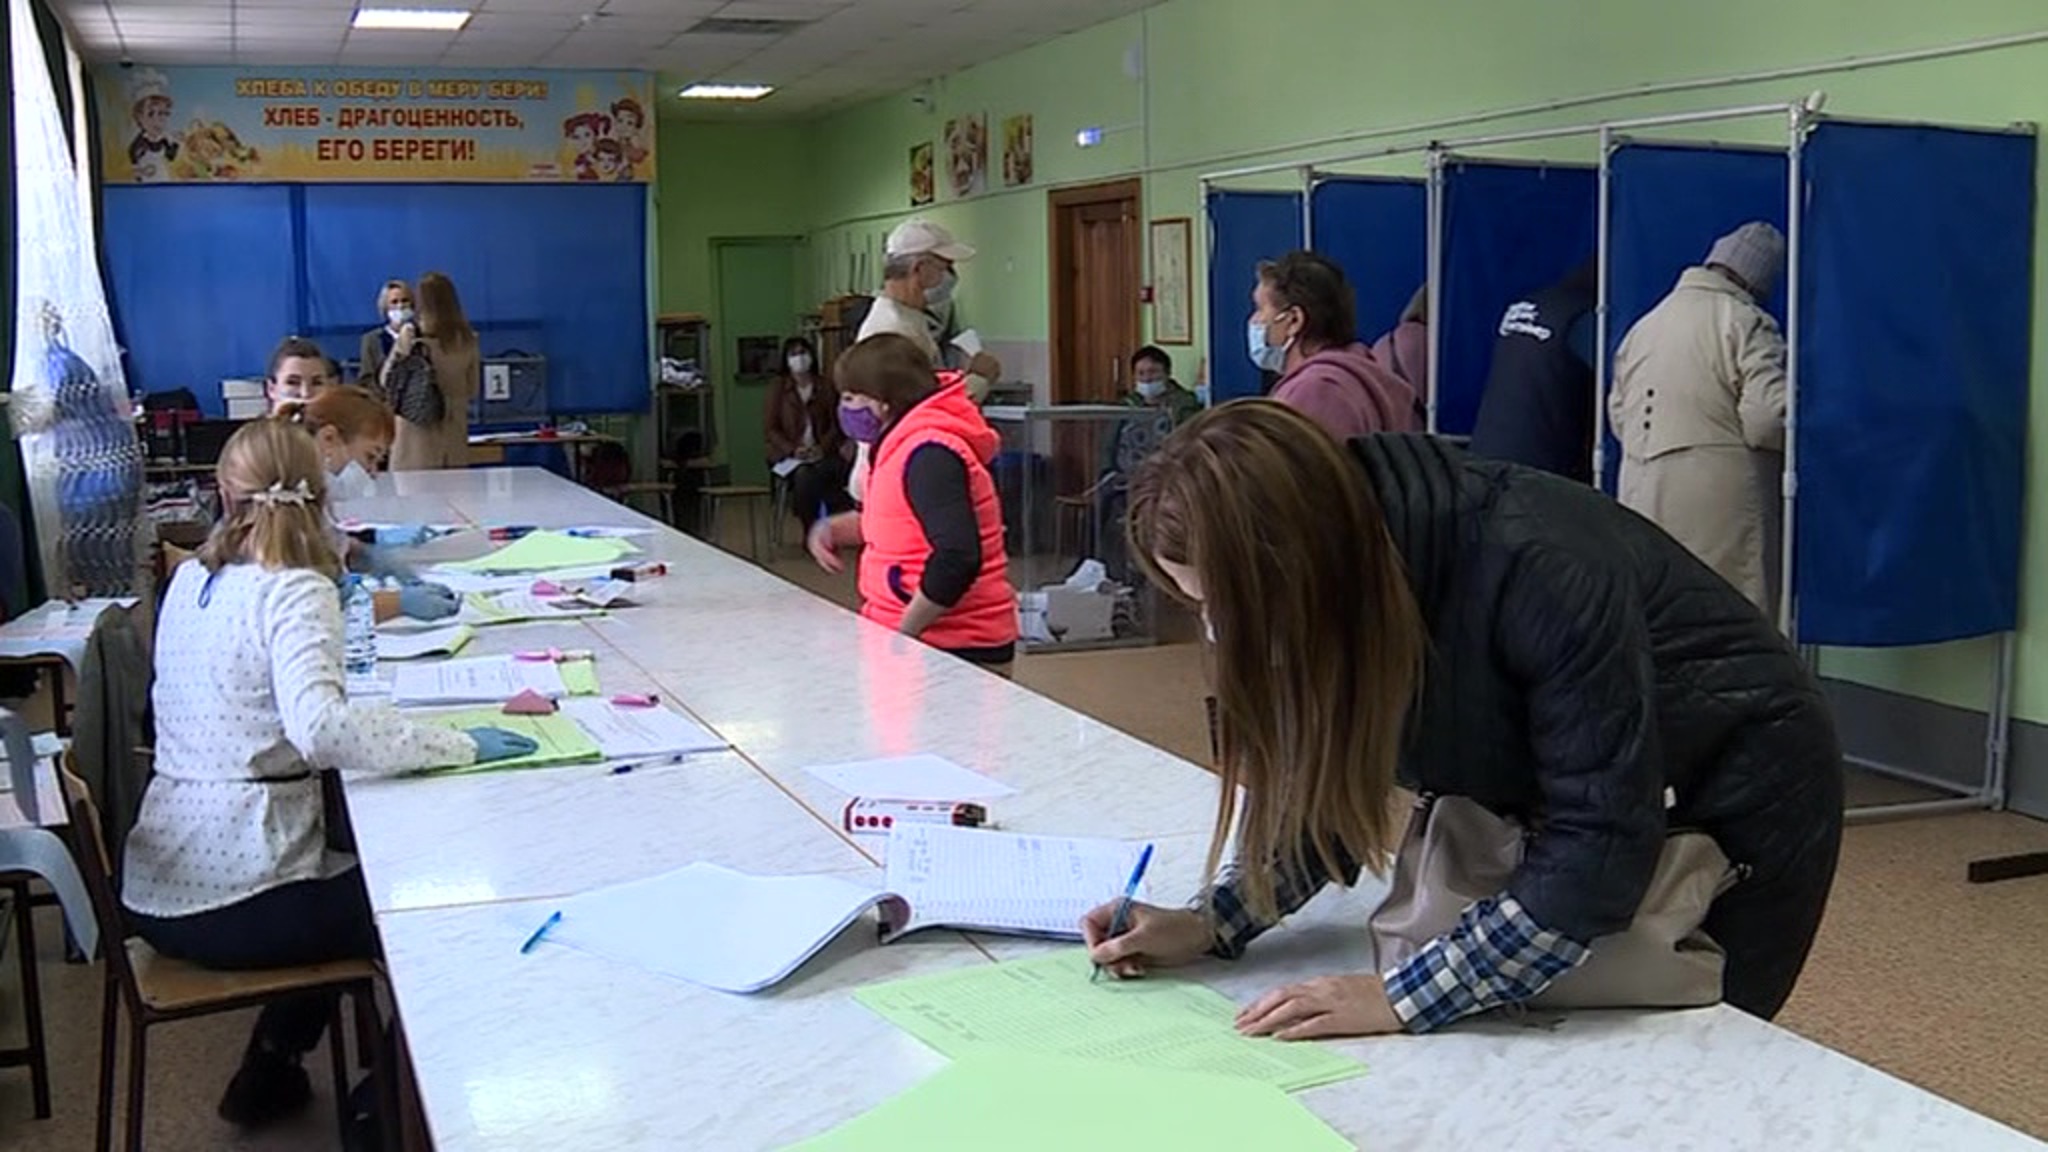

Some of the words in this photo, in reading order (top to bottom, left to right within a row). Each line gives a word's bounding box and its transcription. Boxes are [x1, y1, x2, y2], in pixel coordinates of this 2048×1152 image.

[235, 79, 306, 97] ХЛЕБА
[314, 79, 326, 97] К
[333, 79, 401, 98] ОБЕДУ
[408, 80, 421, 97] В
[428, 80, 480, 98] МЕРУ
[488, 80, 547, 98] БЕРИ!
[264, 107, 320, 126] ХЛЕБ
[338, 107, 524, 129] ДРАГОЦЕННОСТЬ,
[317, 139, 365, 161] ЕГО
[373, 139, 476, 161] БЕРЕГИ!
[493, 374, 506, 395] 1
